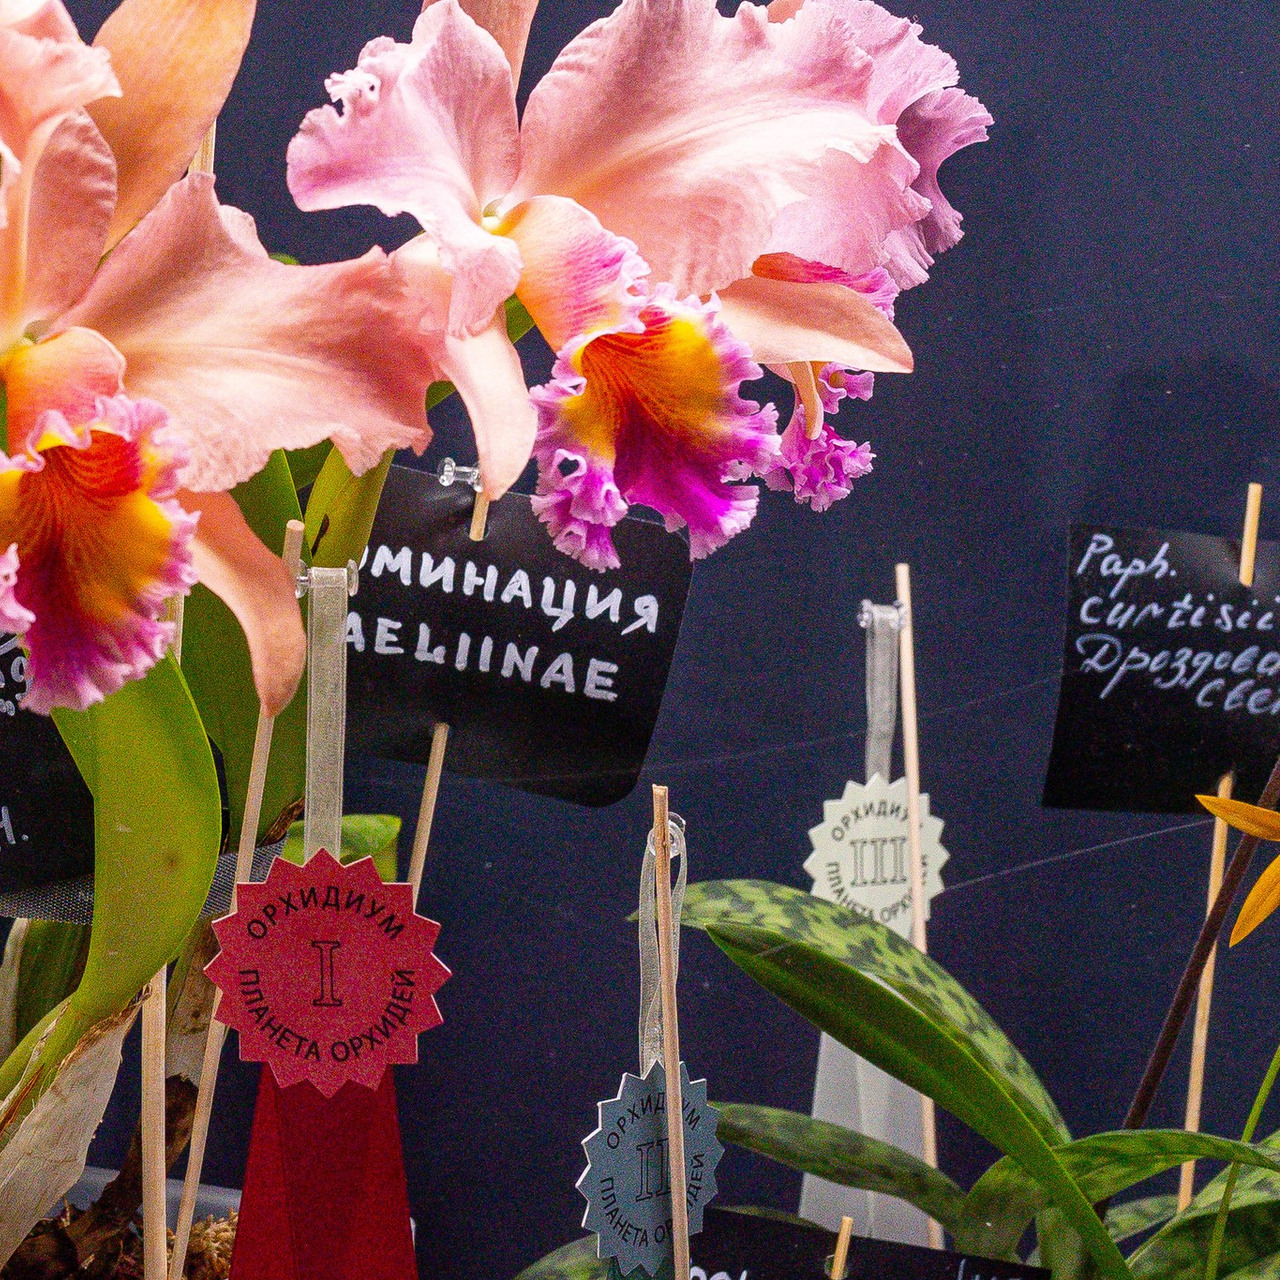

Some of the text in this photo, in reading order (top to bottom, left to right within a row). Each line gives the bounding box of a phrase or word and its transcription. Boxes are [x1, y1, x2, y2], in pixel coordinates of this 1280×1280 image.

[360, 544, 659, 635] МИНАЦИЯ
[1076, 533, 1178, 599] Paph.
[345, 611, 619, 702] AELIINAE
[850, 836, 907, 887] III
[246, 885, 405, 941] ОРХИДИУМ
[311, 940, 343, 1007] I
[238, 969, 416, 1063] ПЛАНЕТА ОРХИДЕЙ
[600, 1176, 649, 1247] ПЛАНЕТА
